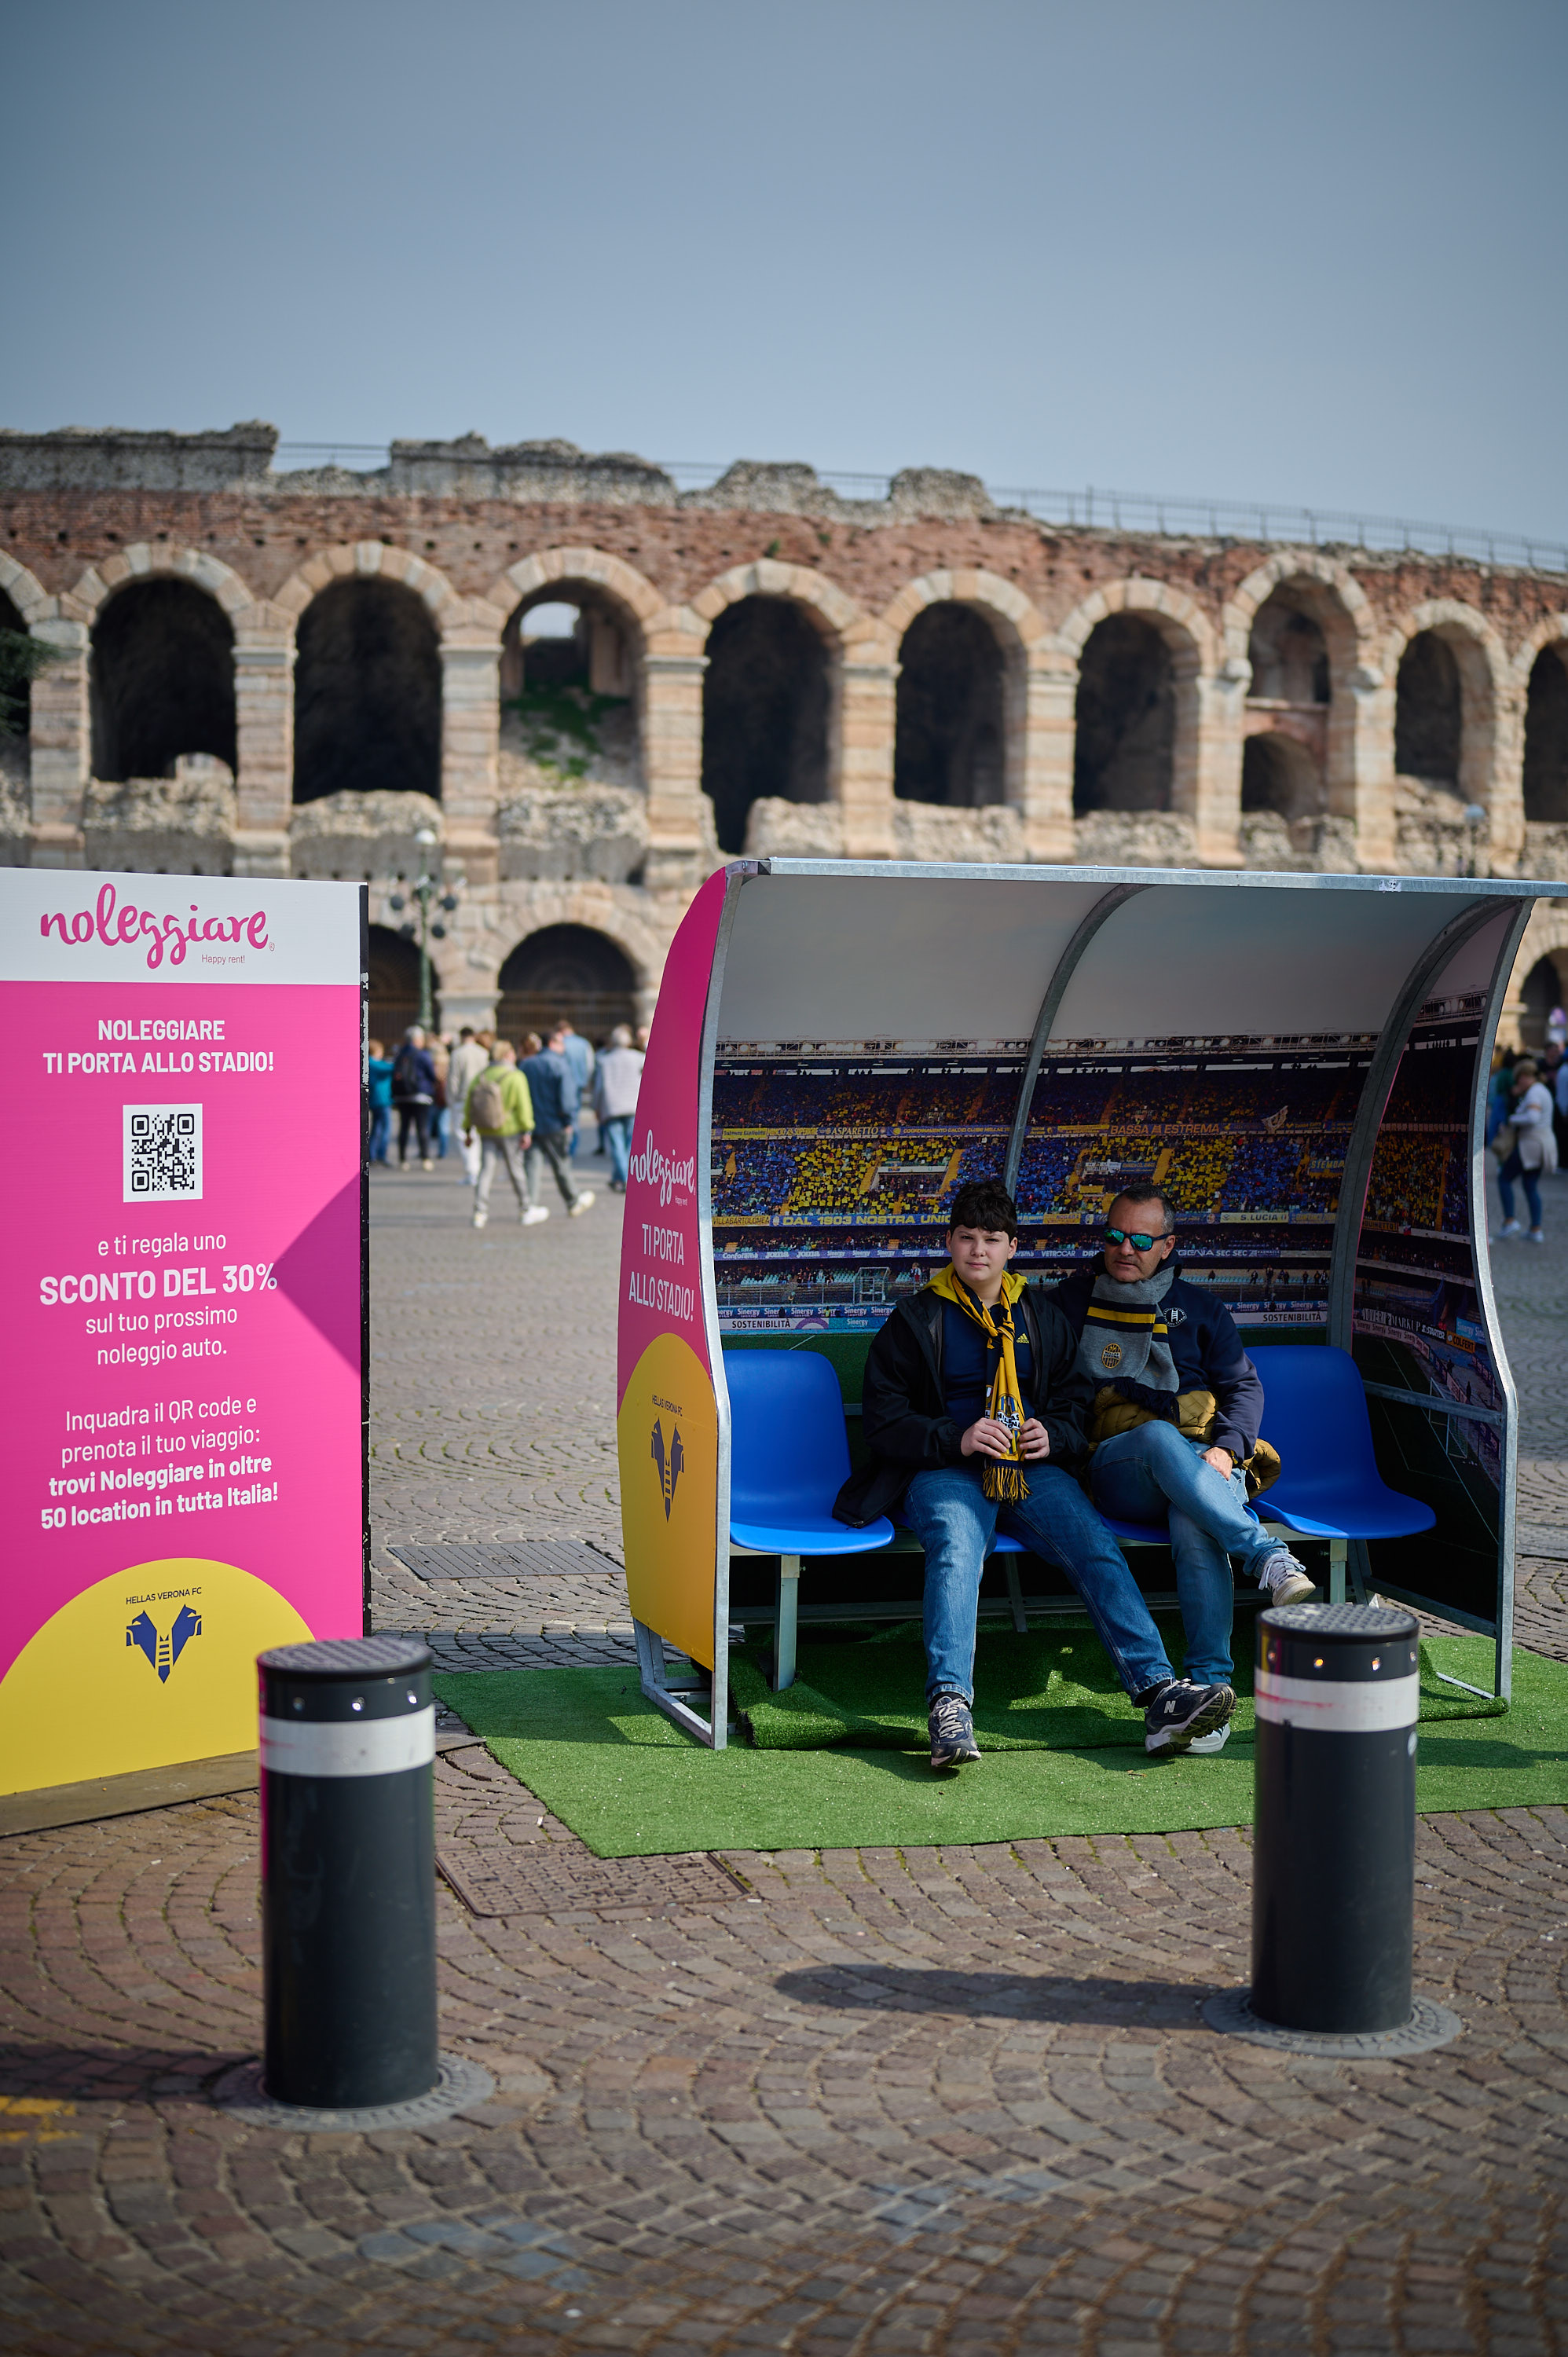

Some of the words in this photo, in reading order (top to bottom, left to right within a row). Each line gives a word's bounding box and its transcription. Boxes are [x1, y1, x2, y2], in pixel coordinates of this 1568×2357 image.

[41, 883, 269, 969] noleggiare
[201, 955, 226, 966] Happy
[229, 955, 245, 963] rent!
[98, 1020, 225, 1040] NOLEGGIARE
[43, 1053, 62, 1073] TI
[68, 1053, 136, 1073] PORTA
[141, 1052, 193, 1072] ALLO
[199, 1052, 273, 1072] STADIO!
[1110, 1124, 1149, 1135] BASSA
[1164, 1124, 1219, 1134] ESTREMA
[630, 1129, 694, 1208] noleggiare
[783, 1216, 812, 1225] DAL
[817, 1216, 852, 1225] 1903
[855, 1215, 916, 1224] NOSTRA
[98, 1241, 108, 1256] e
[114, 1235, 126, 1255] ti
[132, 1233, 189, 1258] regala
[193, 1235, 226, 1251] uno
[642, 1223, 651, 1255] TI
[654, 1226, 684, 1265] PORTA
[40, 1270, 156, 1305] SCONTO
[164, 1267, 216, 1296] DEL
[222, 1263, 277, 1293] 30%
[628, 1271, 655, 1308] ALLO
[658, 1279, 694, 1321] STADIO!
[86, 1313, 113, 1334] sul
[118, 1314, 149, 1331] tuo
[154, 1306, 237, 1334] prossimo
[737, 1307, 760, 1316] Sinergy
[1236, 1302, 1260, 1311] Sinergy
[1291, 1300, 1313, 1309] Sinergy
[1263, 1310, 1321, 1321] SOSTENIBILITÀ
[732, 1318, 790, 1329] SOSTENIBILITÀ
[97, 1340, 178, 1366] noleggio
[182, 1339, 227, 1358] auto.
[1453, 1336, 1475, 1351] COLFERT
[66, 1406, 149, 1434] Inquadra
[155, 1402, 163, 1423] il
[169, 1400, 193, 1424] QR
[198, 1396, 241, 1418] code
[247, 1398, 257, 1413] e
[62, 1440, 136, 1469] prenota
[142, 1435, 151, 1455] il
[156, 1435, 186, 1453] tuo
[190, 1425, 260, 1452] viaggio:
[49, 1477, 95, 1497] trovi
[101, 1463, 204, 1491] Noleggiare
[208, 1459, 225, 1479] in
[229, 1456, 272, 1475] oltre
[41, 1508, 67, 1530] 50
[71, 1500, 151, 1527] location
[156, 1496, 173, 1516] in
[177, 1492, 223, 1513] tutta
[228, 1482, 278, 1506] Italia!
[126, 1594, 156, 1605] HELLAS
[157, 1589, 191, 1601] VERONA
[192, 1586, 202, 1596] FC
